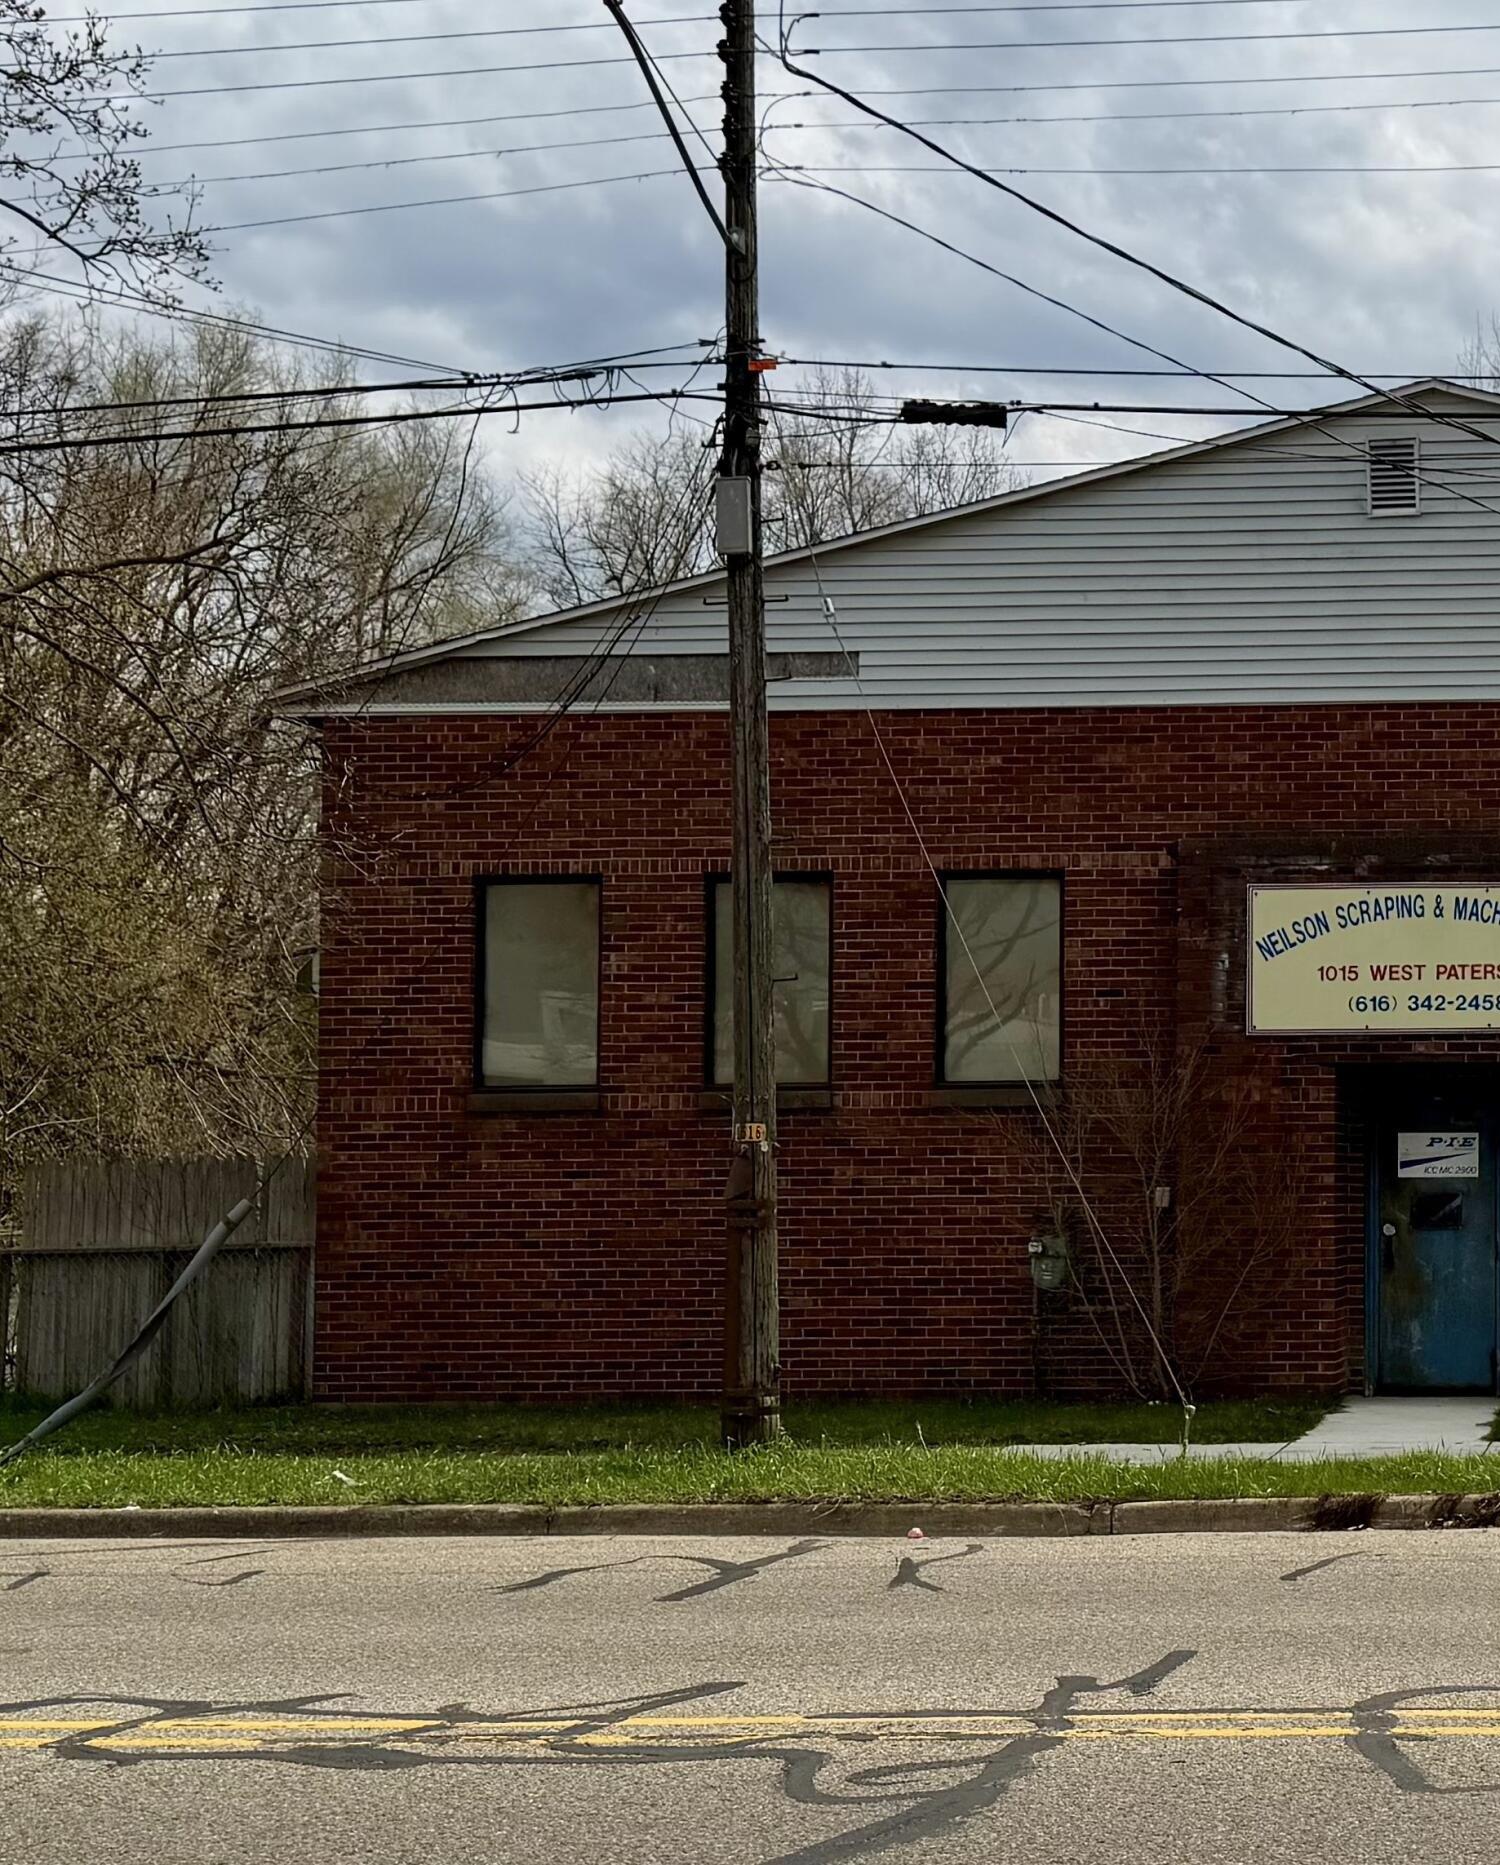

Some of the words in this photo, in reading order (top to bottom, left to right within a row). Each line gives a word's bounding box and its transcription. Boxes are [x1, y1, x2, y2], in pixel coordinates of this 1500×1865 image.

[1255, 910, 1330, 961] NEILSON
[1336, 893, 1424, 929] SCRAPING
[1433, 894, 1444, 918] &
[1318, 966, 1358, 981] 1015
[1370, 965, 1426, 981] WEST
[1349, 995, 1397, 1012] (616)
